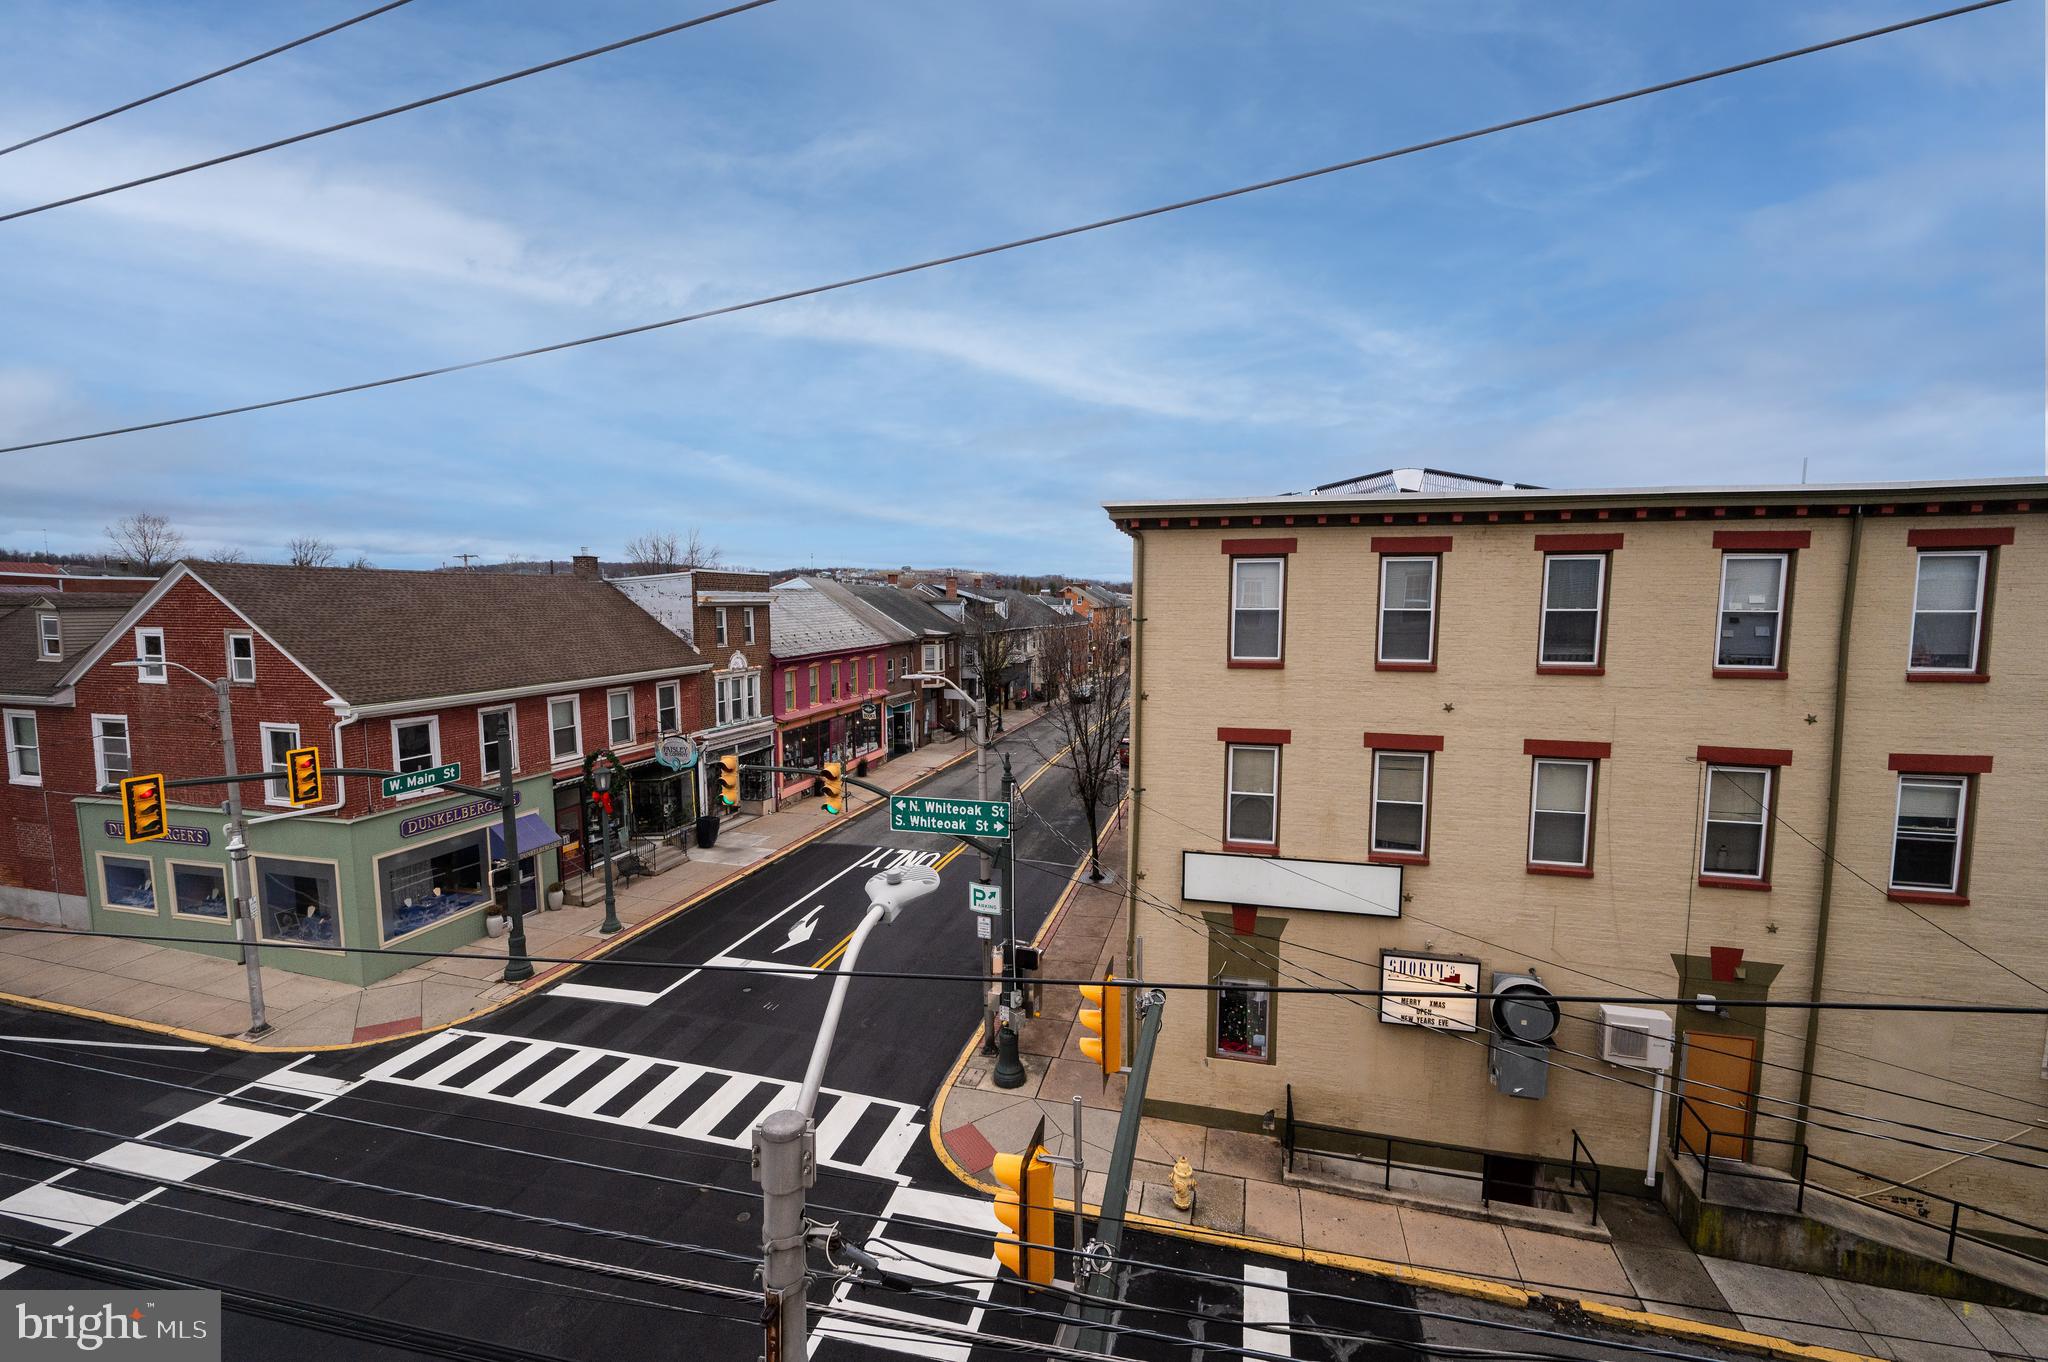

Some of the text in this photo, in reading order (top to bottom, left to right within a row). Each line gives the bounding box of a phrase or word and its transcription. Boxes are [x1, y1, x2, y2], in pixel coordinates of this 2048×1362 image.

[389, 766, 455, 791] W. Main St
[909, 800, 1005, 818] N. Whiteoak St
[895, 814, 989, 832] S. Whiteoak St
[1400, 997, 1446, 1009] MERRY XMAS
[1416, 1008, 1432, 1016] OPEN
[1400, 1014, 1449, 1027] NEW YEARS EVE
